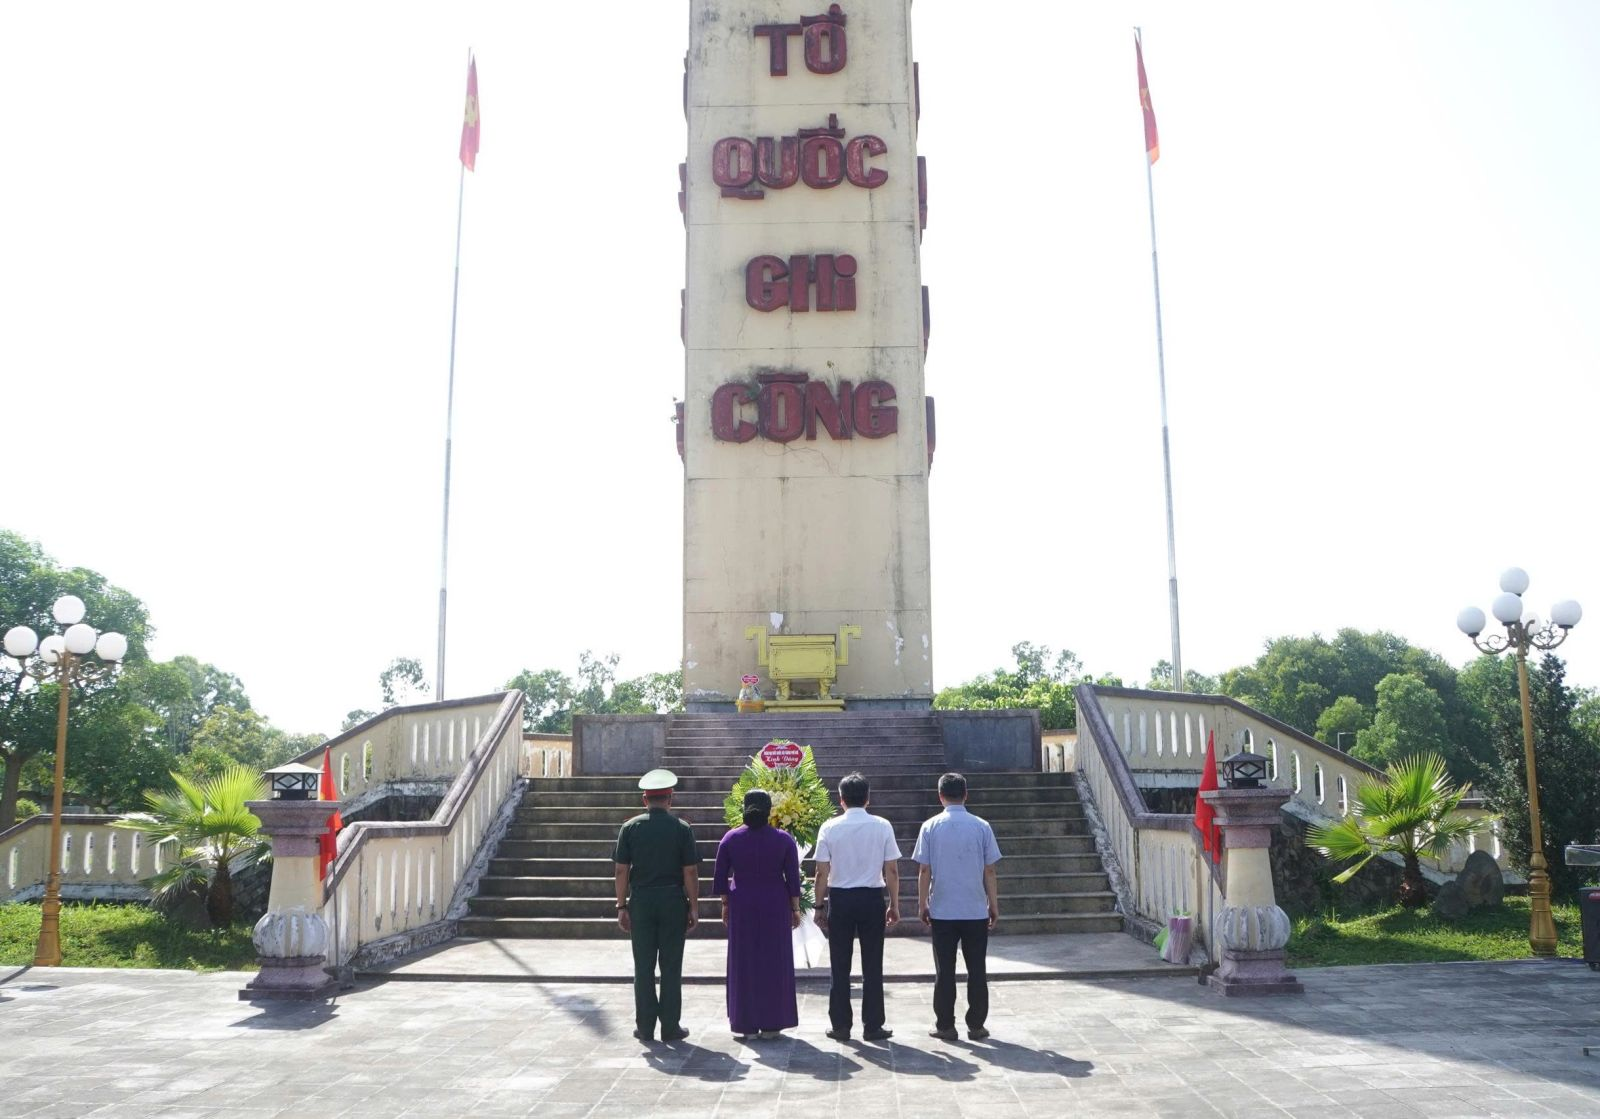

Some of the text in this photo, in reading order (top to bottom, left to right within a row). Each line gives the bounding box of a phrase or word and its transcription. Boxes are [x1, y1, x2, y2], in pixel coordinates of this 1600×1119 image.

[753, 3, 847, 76] TỔ
[711, 113, 889, 200] QUỐC
[711, 372, 898, 443] CÔNG
